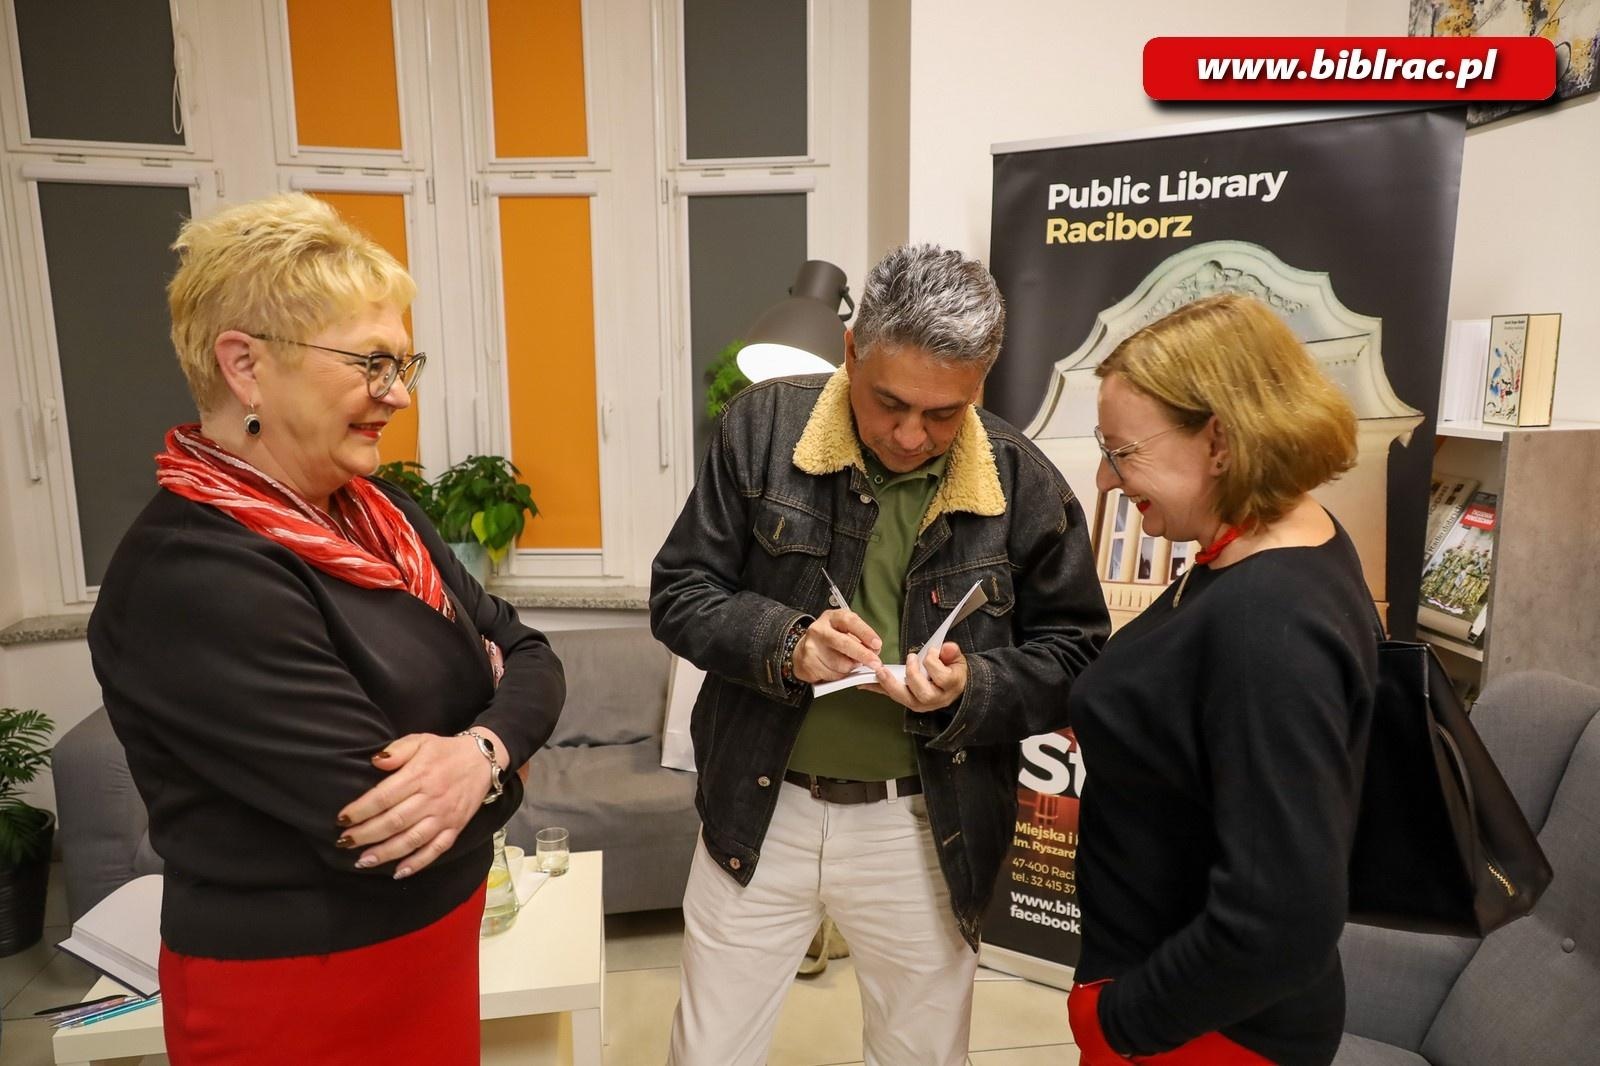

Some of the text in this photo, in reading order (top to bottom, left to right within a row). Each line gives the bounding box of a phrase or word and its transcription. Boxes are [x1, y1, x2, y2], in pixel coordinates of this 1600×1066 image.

[1048, 170, 1289, 211] Public Library
[1046, 213, 1193, 245] Raciborz
[1015, 821, 1066, 842] Miejska
[1068, 832, 1073, 845] i
[1013, 835, 1076, 860] im. Ryszard
[1012, 857, 1075, 881] 47-400 Raci
[1031, 875, 1044, 888] 32
[1045, 879, 1062, 892] 415
[1010, 891, 1081, 919] www.bib
